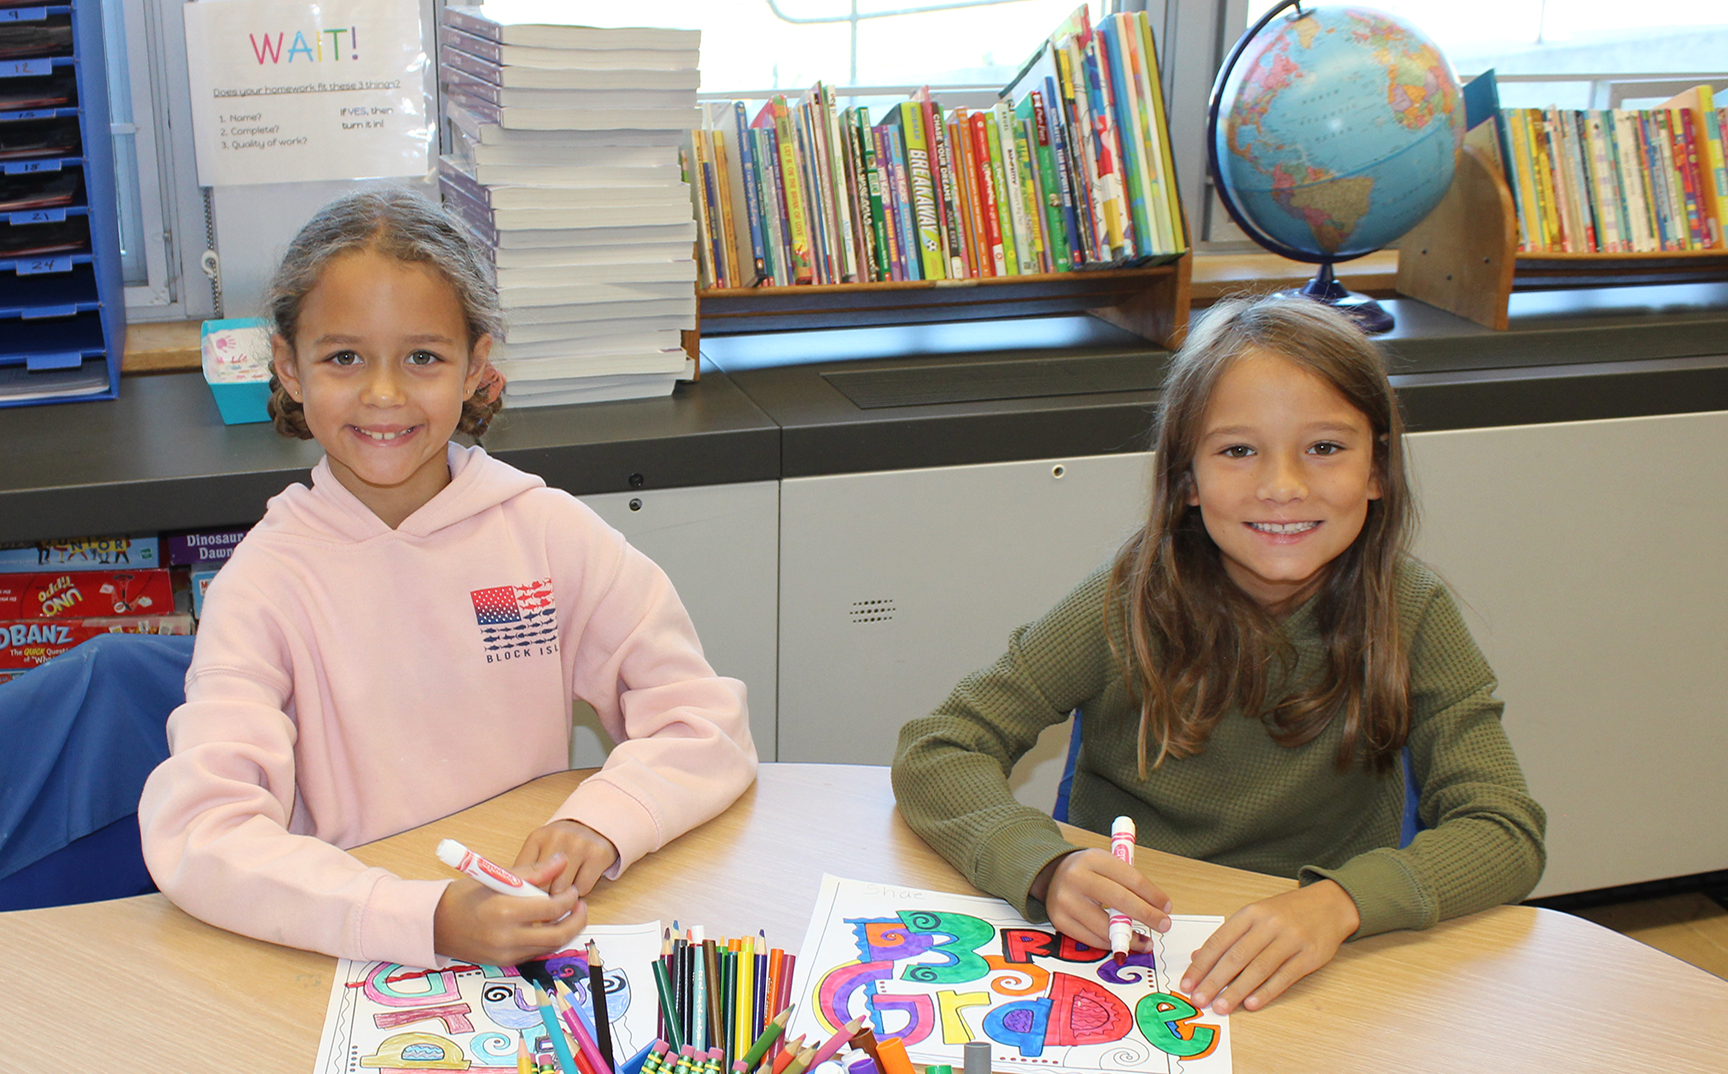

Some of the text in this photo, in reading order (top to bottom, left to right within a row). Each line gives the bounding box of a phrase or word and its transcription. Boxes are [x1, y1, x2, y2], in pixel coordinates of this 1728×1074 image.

[249, 26, 358, 65] WAIT!
[15, 62, 34, 73] 12
[213, 79, 401, 97] Does your homework fit these 3 things?
[219, 113, 262, 123] 1. Name?
[348, 107, 369, 116] YES,
[370, 107, 394, 115] then
[341, 120, 384, 130] turn it in!
[910, 106, 921, 140] MORGAN
[933, 113, 945, 141] CHASE
[220, 126, 280, 138] 2. Complete?
[221, 137, 308, 150] 3. Quality of work?
[937, 142, 948, 166] YOUR
[1057, 148, 1066, 164] YEAR
[786, 166, 794, 176] ON
[788, 178, 796, 189] THE
[939, 167, 951, 201] DREAMS
[1060, 171, 1069, 192] SPORTS
[908, 148, 938, 234] BREAKAWAY
[32, 212, 49, 221] 21
[794, 211, 801, 220] OF
[946, 208, 955, 229] JULIE
[795, 221, 804, 236] LOVE
[950, 230, 958, 248] ERTZ
[32, 259, 55, 270] 24
[186, 532, 244, 547] Dinosaur
[199, 547, 234, 560] Dawn
[42, 588, 83, 615] UNO
[24, 648, 45, 656] QUICK
[486, 648, 531, 664] BLOCK
[862, 884, 926, 901] Shae
